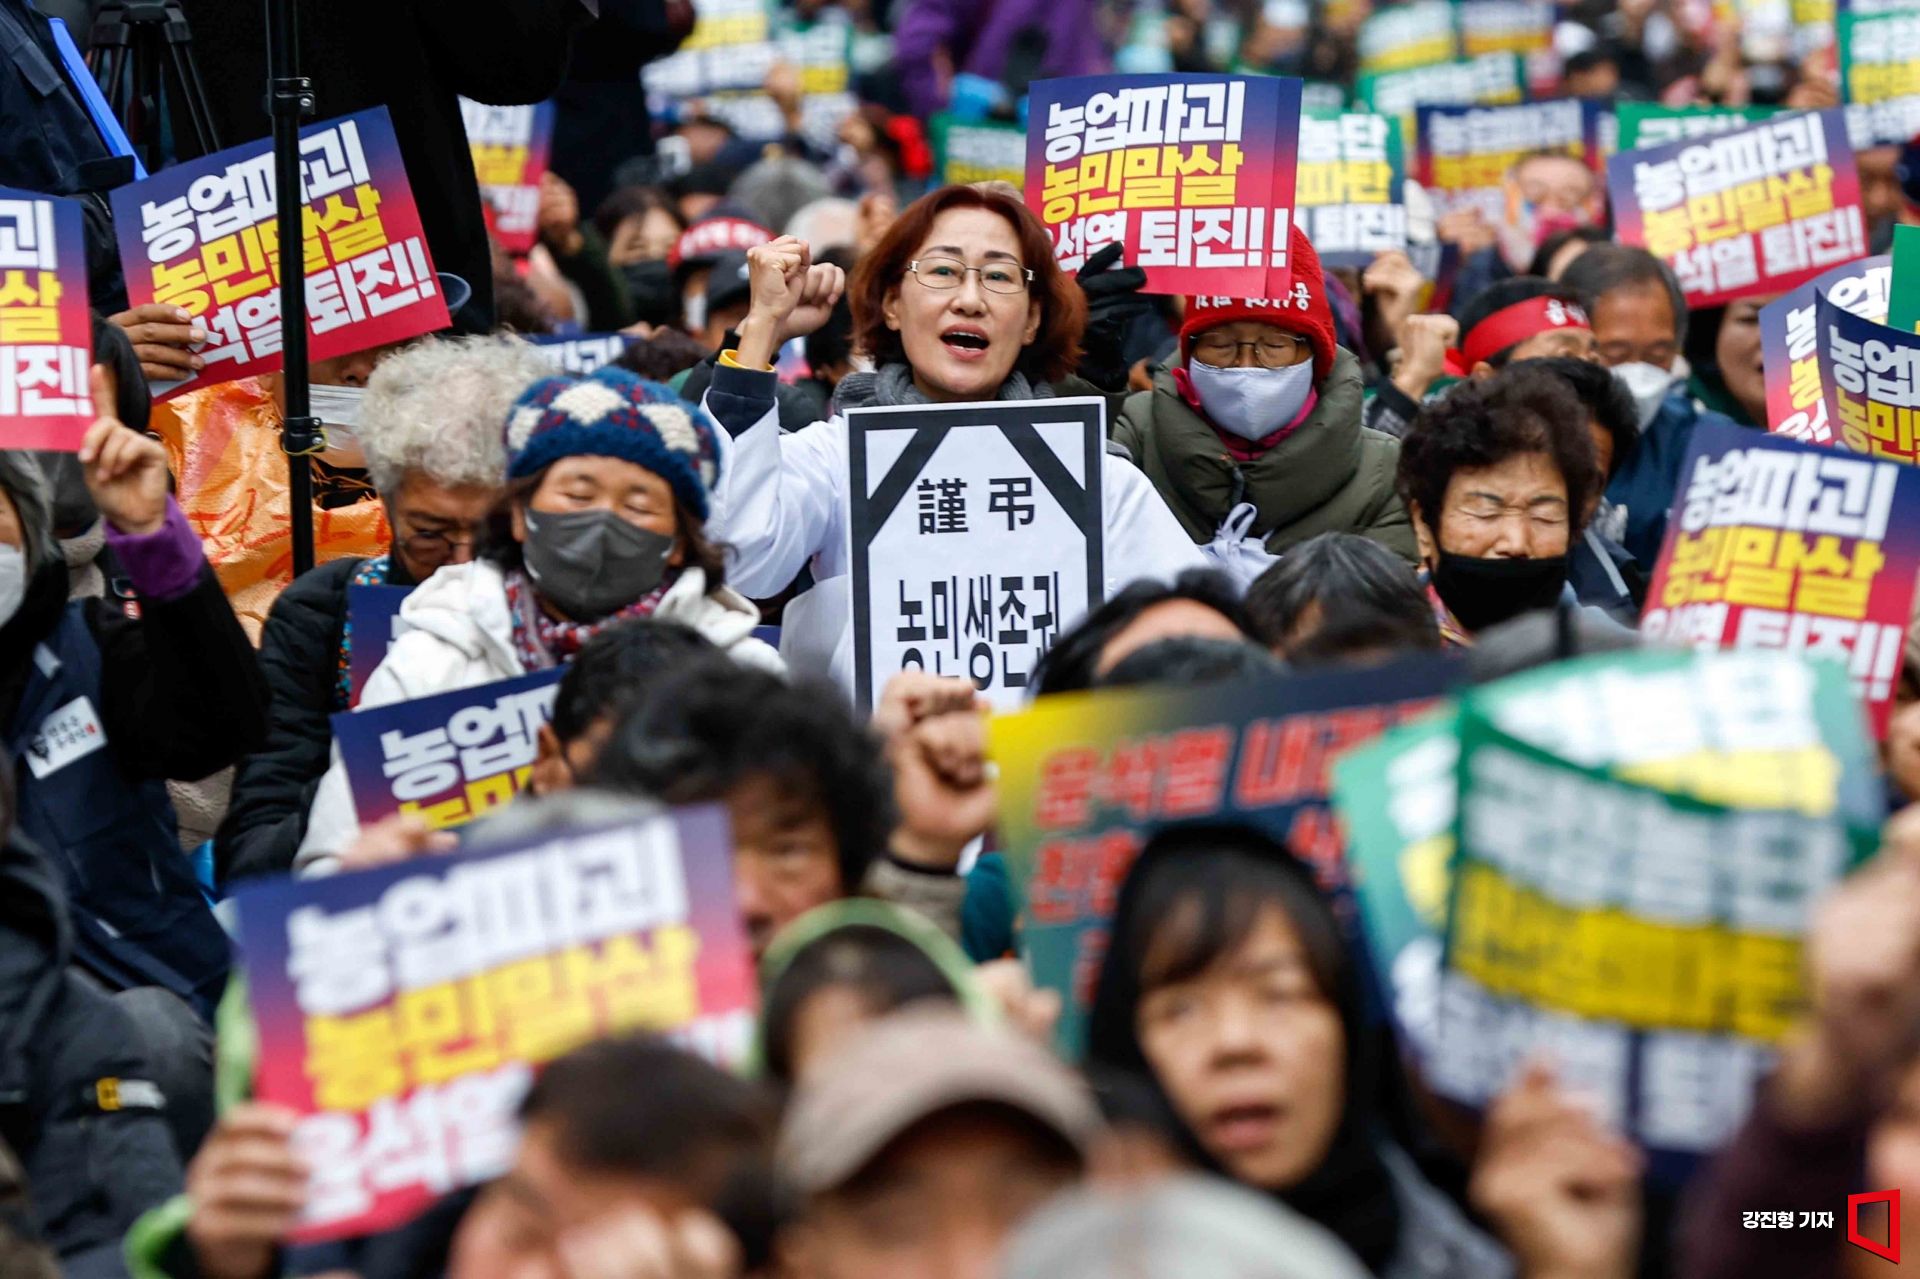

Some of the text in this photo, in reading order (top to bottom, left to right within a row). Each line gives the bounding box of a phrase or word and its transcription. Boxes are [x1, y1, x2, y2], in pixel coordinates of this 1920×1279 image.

[1045, 80, 1246, 163] 농업파괴
[1634, 111, 1829, 211] 농업파괴
[1042, 143, 1244, 225] 농민말살
[1643, 163, 1834, 259] 농민말살
[1043, 210, 1128, 273] 석열
[1672, 232, 1759, 294] 석열
[190, 286, 285, 366] 석열
[1681, 447, 1899, 543] 농업파괴
[1662, 524, 1886, 621] 농민말살
[896, 571, 1061, 691] 농민생존권
